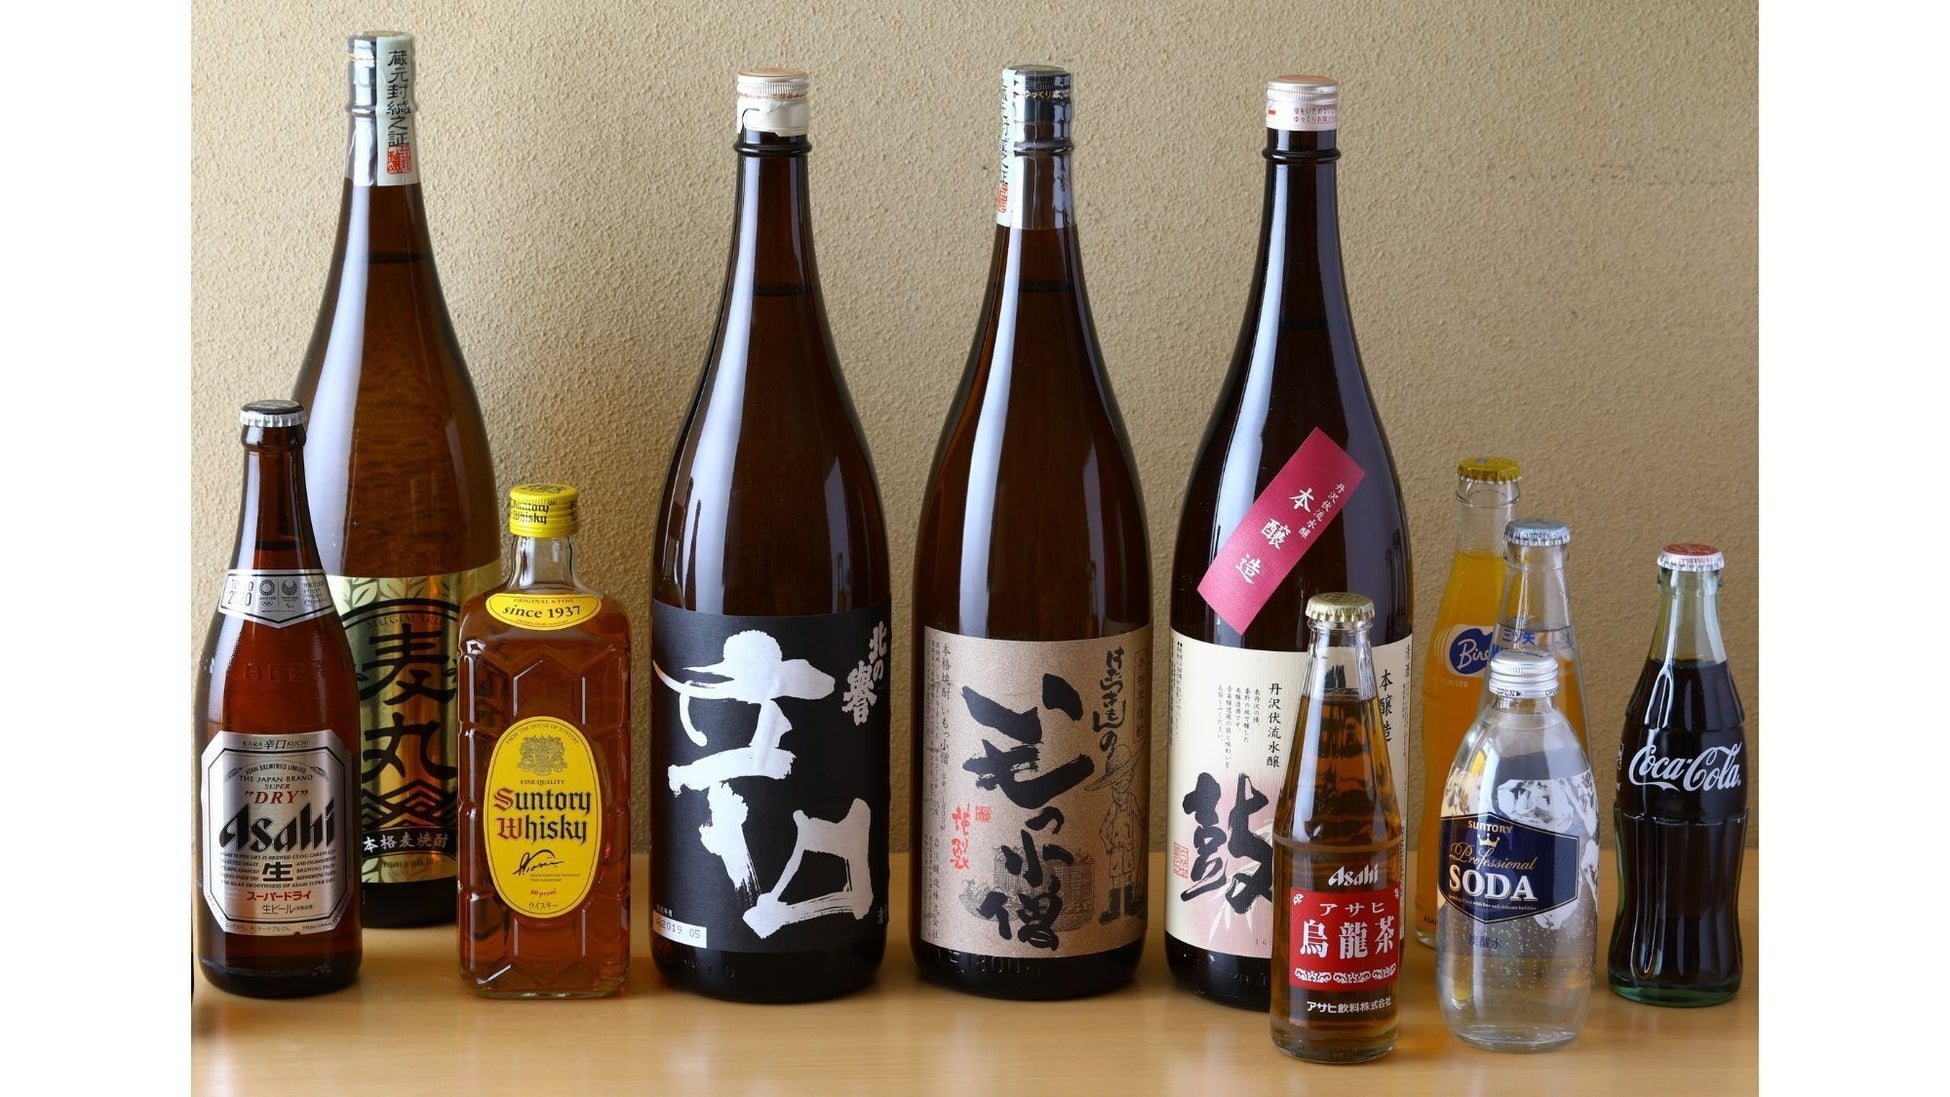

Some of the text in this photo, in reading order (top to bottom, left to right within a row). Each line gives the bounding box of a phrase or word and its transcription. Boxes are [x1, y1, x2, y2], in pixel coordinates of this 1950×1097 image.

[1298, 483, 1346, 540] 丹沢伏流水醸
[1234, 487, 1315, 585] 本醸造
[502, 604, 580, 618] since 1937
[1502, 628, 1535, 646] 三ツ矢
[1266, 683, 1282, 768] 丹沢伏流水醸
[242, 739, 309, 749] KARA 辛口 KUCHI
[240, 774, 313, 783] THE JAPAN BRAND
[1628, 742, 1742, 792] Coca-Cola
[493, 787, 591, 816] Suntory
[219, 798, 335, 852] Asahi
[496, 814, 589, 847] Whisky
[362, 831, 449, 853] 本格麦焼酎
[1449, 841, 1538, 871] Professional
[262, 861, 294, 882] 生
[1328, 863, 1379, 887] Asahi
[1449, 864, 1539, 902] SODA
[246, 890, 312, 901] スーパードライ
[528, 901, 559, 910] ウイスキー
[1319, 902, 1385, 917] アサヒ
[1300, 915, 1395, 960] 烏龍茶
[1468, 934, 1502, 949] 炭酸水
[1306, 996, 1393, 1014] アサヒ飲料株式会社
